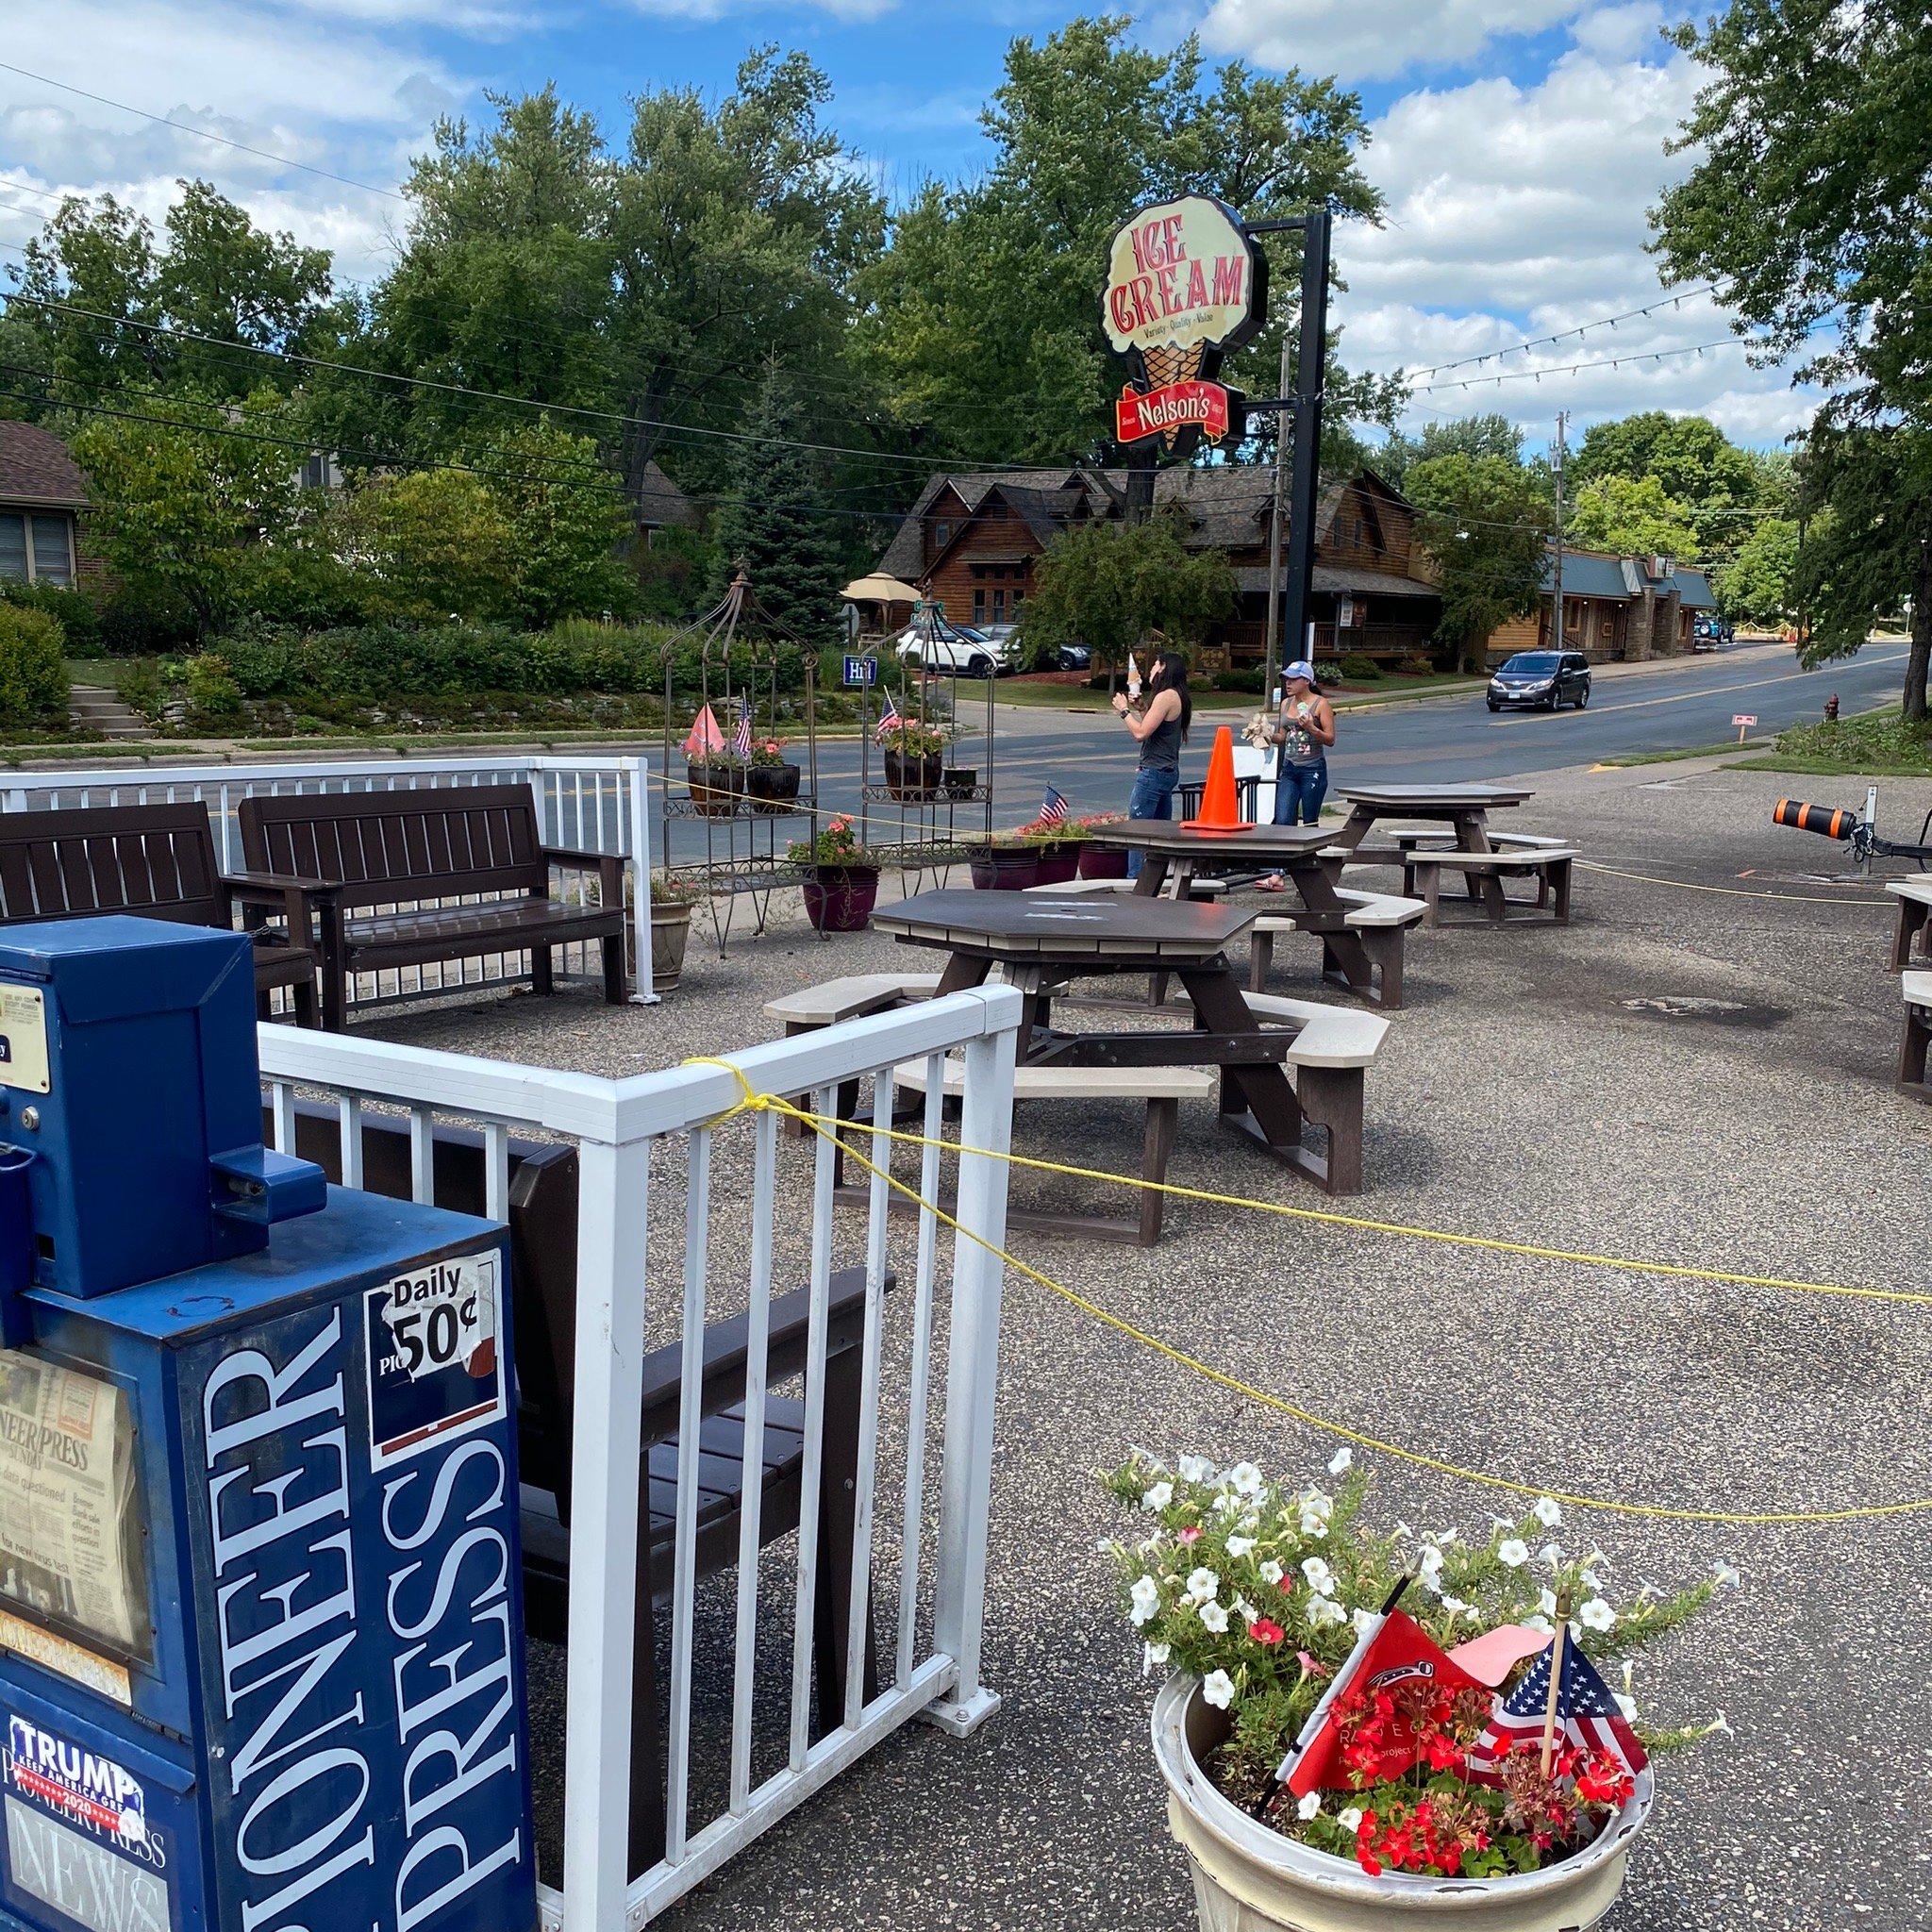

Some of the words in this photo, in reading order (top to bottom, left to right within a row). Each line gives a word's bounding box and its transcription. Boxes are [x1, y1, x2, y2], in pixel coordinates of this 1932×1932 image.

[1130, 214, 1187, 274] ICE
[1110, 256, 1245, 334] CREAM
[1143, 325, 1166, 339] Variety
[1170, 317, 1191, 331] Quality
[1196, 312, 1213, 324] Value
[1137, 387, 1210, 431] Nelson's
[849, 661, 872, 679] Hil
[393, 1266, 461, 1307] Daily
[393, 1289, 477, 1372] 50¢
[38, 1424, 89, 1472] PRESS
[21, 1478, 66, 1504] questioned
[203, 1306, 378, 1932] IONEER
[381, 1439, 520, 1932] PRESS
[19, 1724, 137, 1804] TRUMP
[19, 1754, 45, 1775] KEEP
[47, 1768, 98, 1803] AMERICA
[62, 1790, 93, 1817] 2020
[10, 1806, 170, 1932] NEWS
